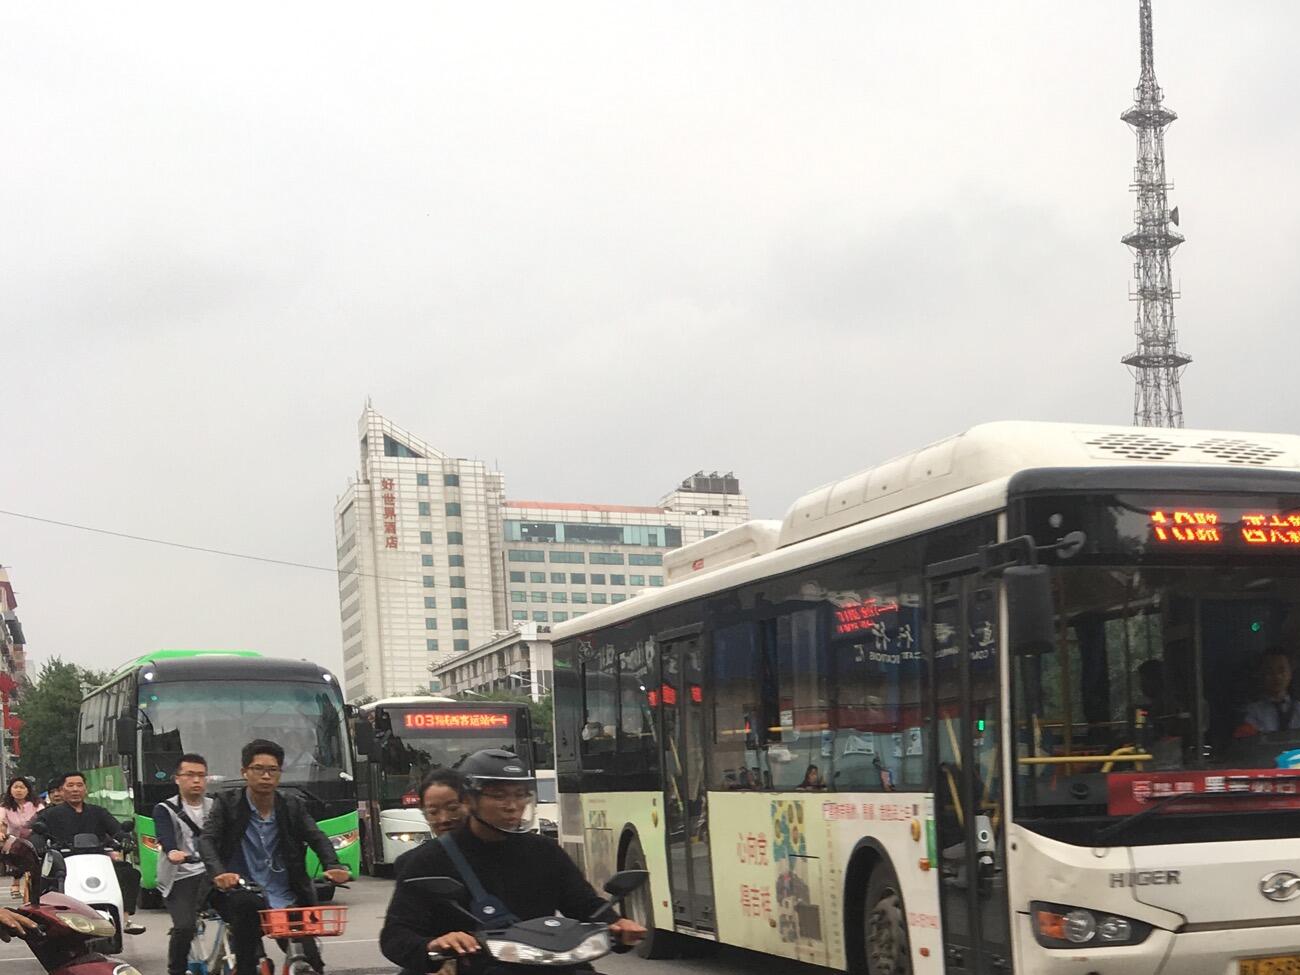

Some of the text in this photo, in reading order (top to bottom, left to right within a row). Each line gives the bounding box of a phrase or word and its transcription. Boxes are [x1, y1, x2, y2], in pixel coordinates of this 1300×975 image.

[381, 478, 398, 549] 好世界酒店
[1109, 870, 1182, 888] HIGER
